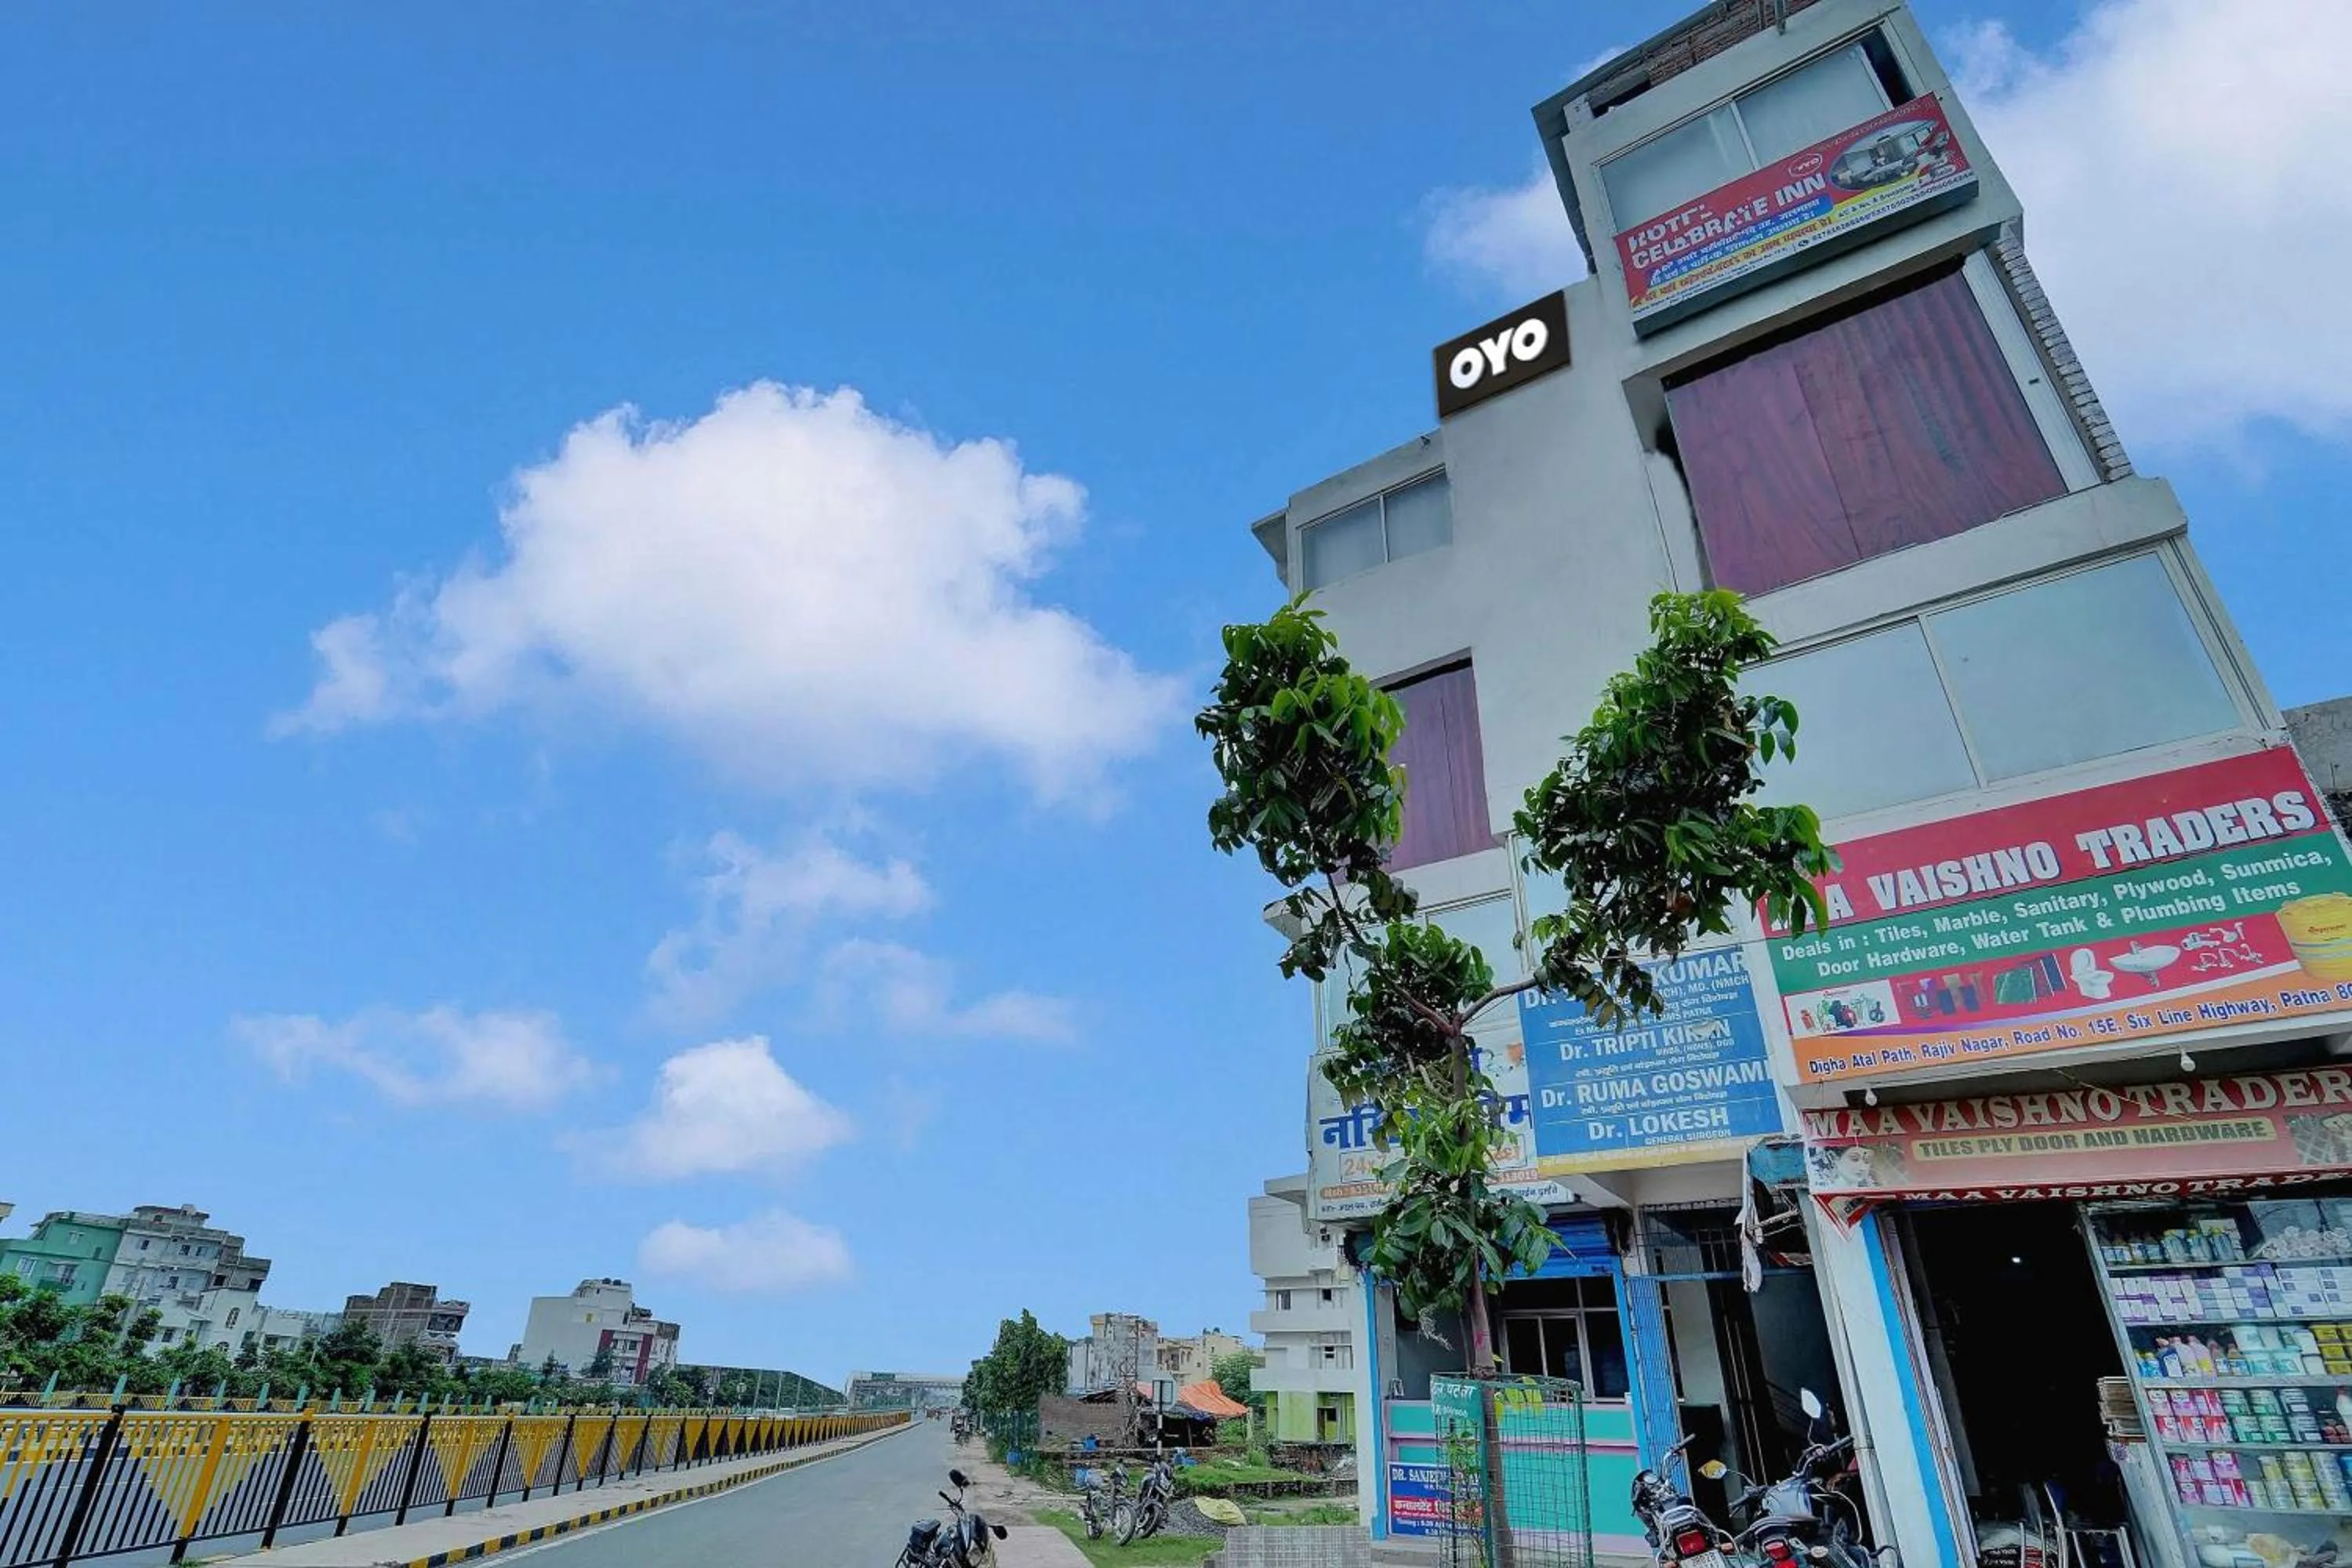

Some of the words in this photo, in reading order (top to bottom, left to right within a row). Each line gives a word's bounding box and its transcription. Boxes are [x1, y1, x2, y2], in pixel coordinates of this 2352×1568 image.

[1774, 173, 1827, 207] INN
[1450, 318, 1549, 389] OYO
[1867, 841, 2062, 911] VAISHNO
[2076, 790, 2318, 870] TRADERS
[1781, 941, 1832, 961] Deals
[1838, 935, 1856, 951] in
[1875, 923, 1929, 944] Tiles,
[1933, 907, 2009, 934] Marble,
[2013, 890, 2109, 919] Sanitary,
[2113, 870, 2215, 901] Plywood,
[2220, 848, 2332, 880] Sunmica,
[1817, 957, 1861, 978] Door
[1867, 942, 1965, 969] Hardware,
[1971, 928, 2030, 955] Water
[2040, 916, 2088, 938] Tank
[2096, 910, 2114, 929] &
[2121, 892, 2226, 924] Plumbing
[2232, 880, 2301, 904] Items
[1524, 989, 1556, 1009] Dr.
[1651, 949, 1745, 986] KUMAR
[1559, 1042, 1588, 1062] Dr.
[1592, 1028, 1657, 1056] TRIPTI
[1809, 1055, 1846, 1075] Digha
[1852, 1052, 1878, 1068] Atal
[1881, 1048, 1917, 1065] Path,
[1922, 1041, 1955, 1060] Rajiv
[1960, 1036, 2009, 1054] Nagar,
[2013, 1025, 2051, 1045] Road
[2056, 1022, 2082, 1040] No.
[2088, 1018, 2122, 1036] 15E,
[2128, 1013, 2153, 1029] Six
[2158, 1008, 2193, 1025] Line
[2198, 996, 2277, 1021] Highway,
[2280, 988, 2332, 1007] Patna
[1541, 1088, 1572, 1109] Dr.
[1577, 1077, 1647, 1105] RUMA
[1588, 1120, 1623, 1141] Dr.
[1627, 1106, 1730, 1137] LOKESH
[1808, 1105, 1907, 1138] MAA
[1906, 1086, 2122, 1134] VAISHNO
[1644, 1133, 1686, 1145] GENERAL
[1919, 1139, 1974, 1157] TILES
[1977, 1137, 2013, 1154] PLY
[2020, 1134, 2078, 1152] DOOR
[2083, 1130, 2129, 1149] AND
[2132, 1120, 2268, 1145] HARDWARE
[1903, 1189, 1987, 1201] MAA
[1994, 1181, 2180, 1200] VAISHNO
[1392, 1468, 1407, 1482] DR.
